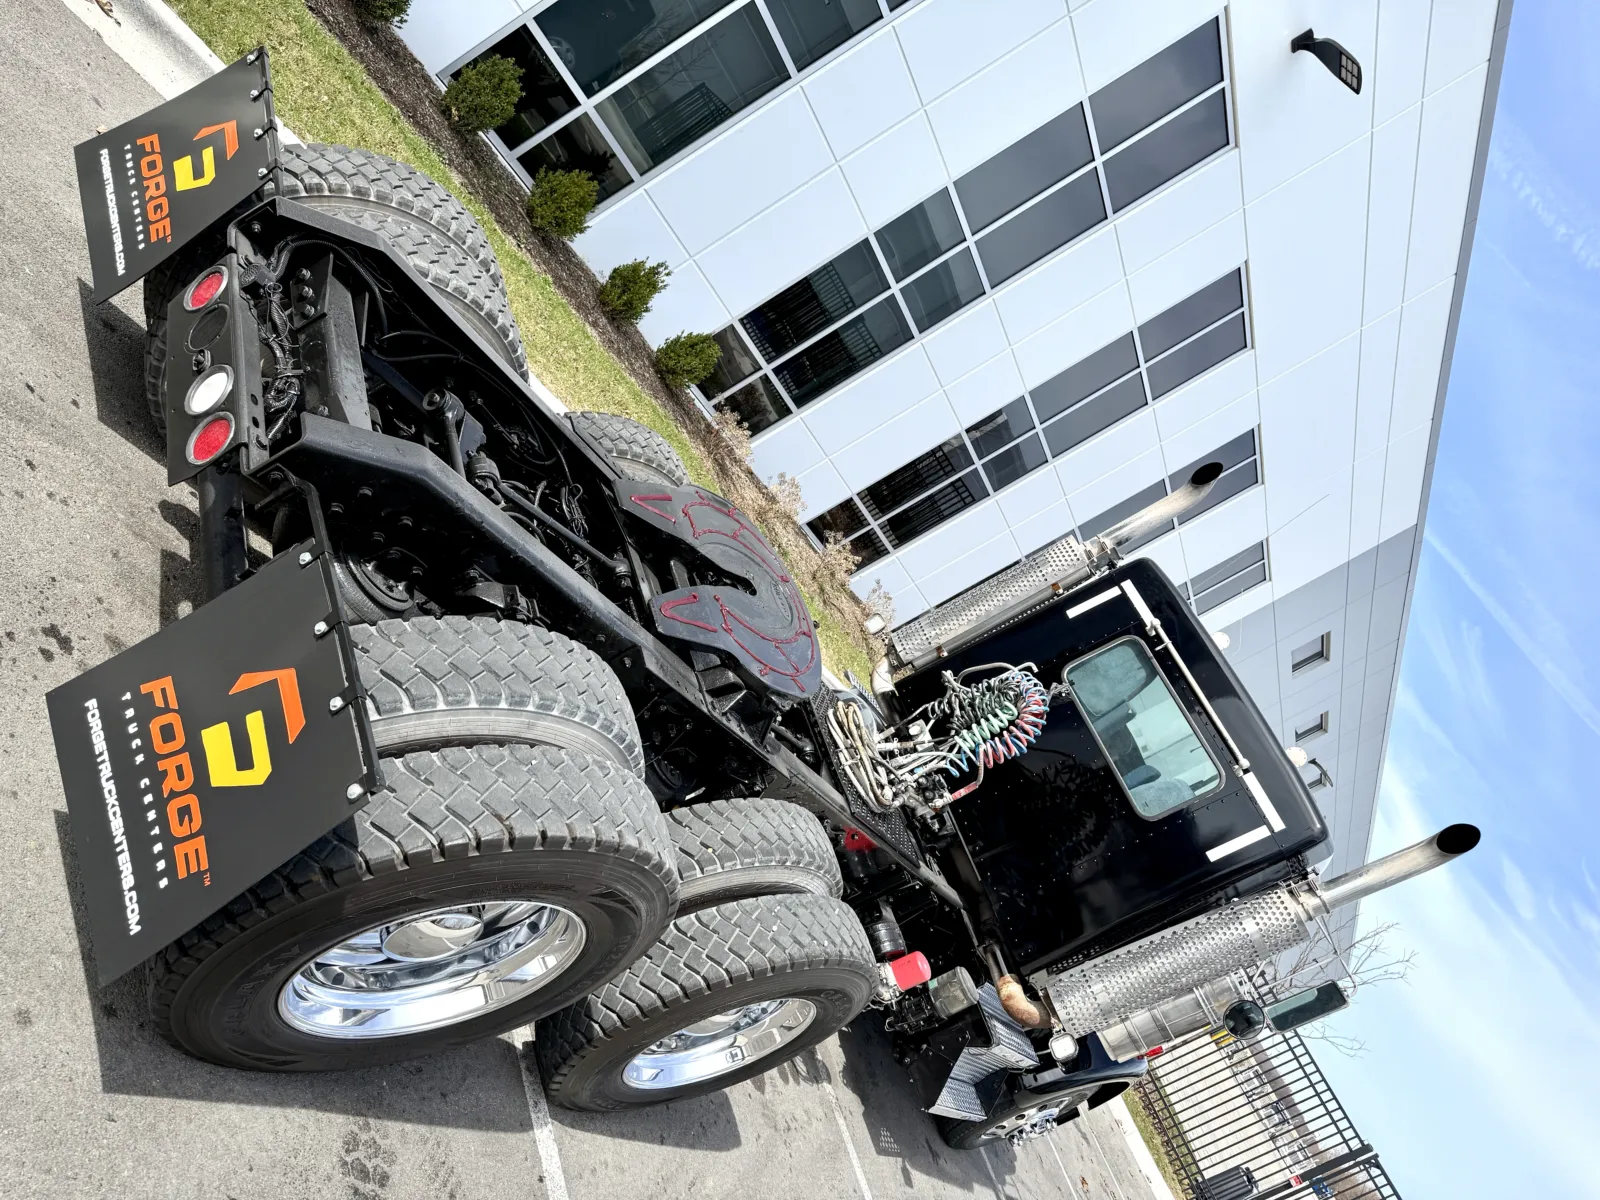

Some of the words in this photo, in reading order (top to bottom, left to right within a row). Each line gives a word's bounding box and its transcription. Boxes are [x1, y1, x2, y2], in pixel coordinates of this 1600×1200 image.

[100, 148, 126, 277] FORGETRUCKCENTERS.COM
[124, 144, 136, 185] TRUCK
[131, 191, 145, 250] CENTERS
[136, 133, 171, 243] FORGE
[84, 698, 142, 936] FORGETRUCKCENTERS.COM
[121, 691, 145, 765] TRUCK
[140, 777, 169, 889] CENTERS
[140, 675, 209, 880] FORGE
